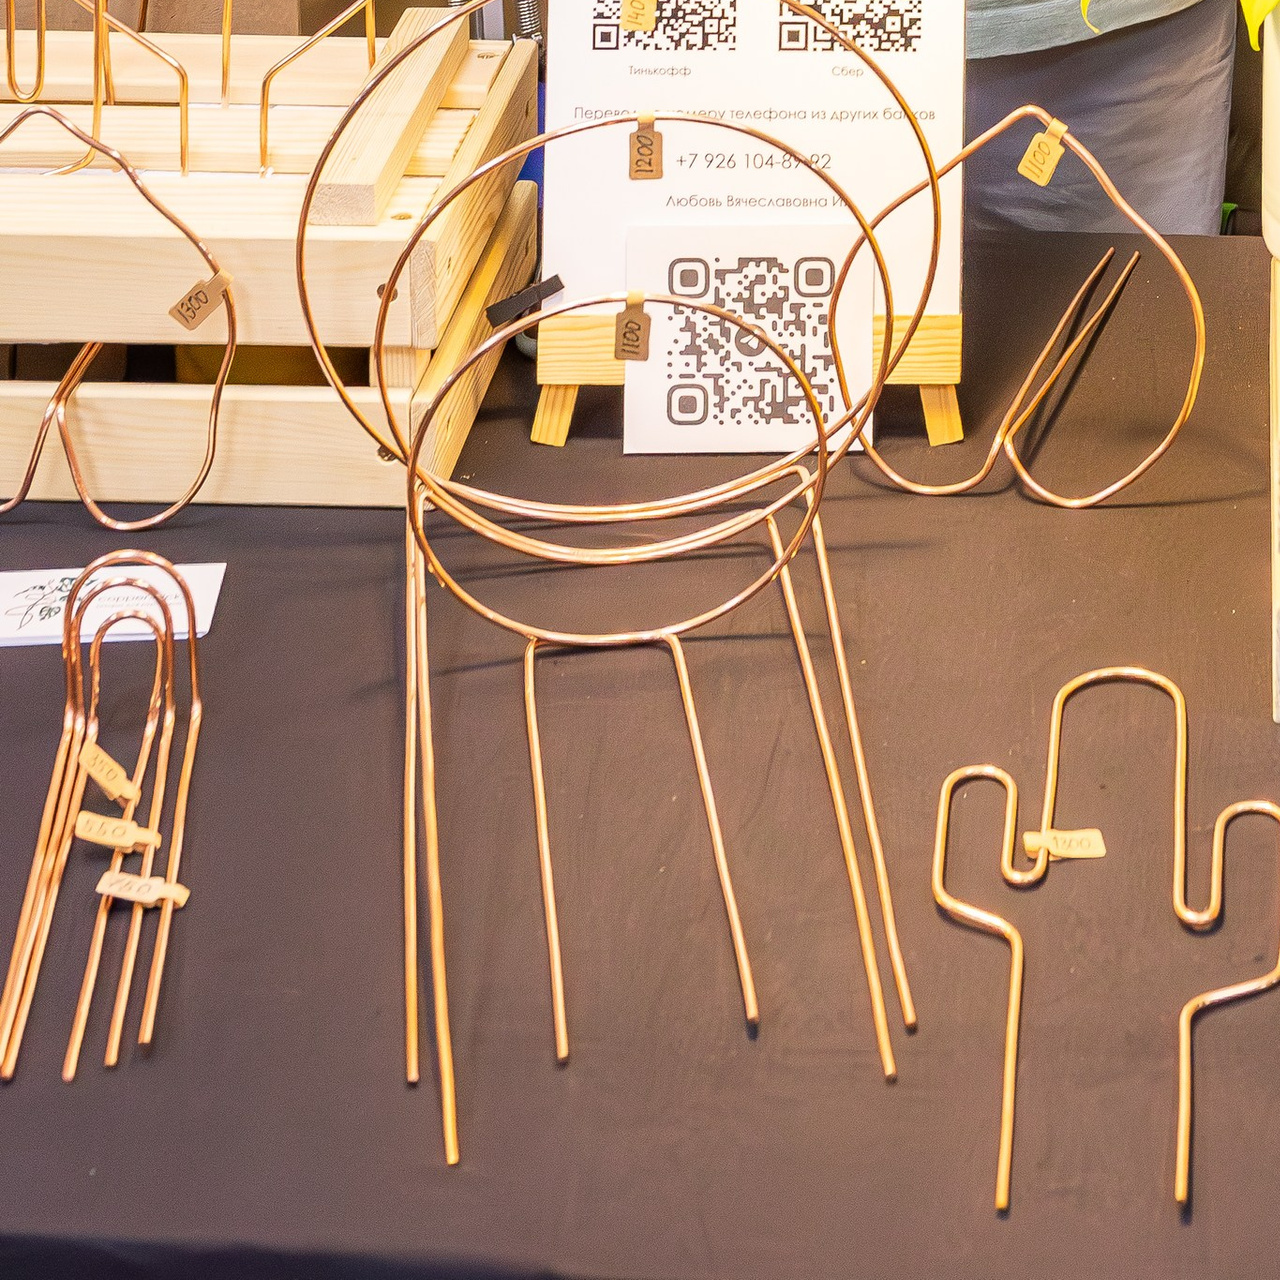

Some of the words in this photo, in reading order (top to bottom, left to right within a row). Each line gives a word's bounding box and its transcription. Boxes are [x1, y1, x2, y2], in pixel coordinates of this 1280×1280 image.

[628, 65, 692, 78] Тинькофф
[831, 65, 864, 78] Сбер
[731, 108, 807, 122] телефона
[811, 111, 826, 120] из
[830, 109, 879, 122] других
[635, 134, 655, 174] 1200
[676, 153, 698, 169] +7
[704, 153, 737, 170] 926
[1023, 140, 1052, 179] 1100
[666, 195, 723, 208] Любовь
[726, 195, 828, 208] Вячеславовна
[177, 289, 209, 324] 1300
[621, 319, 643, 358] 1100
